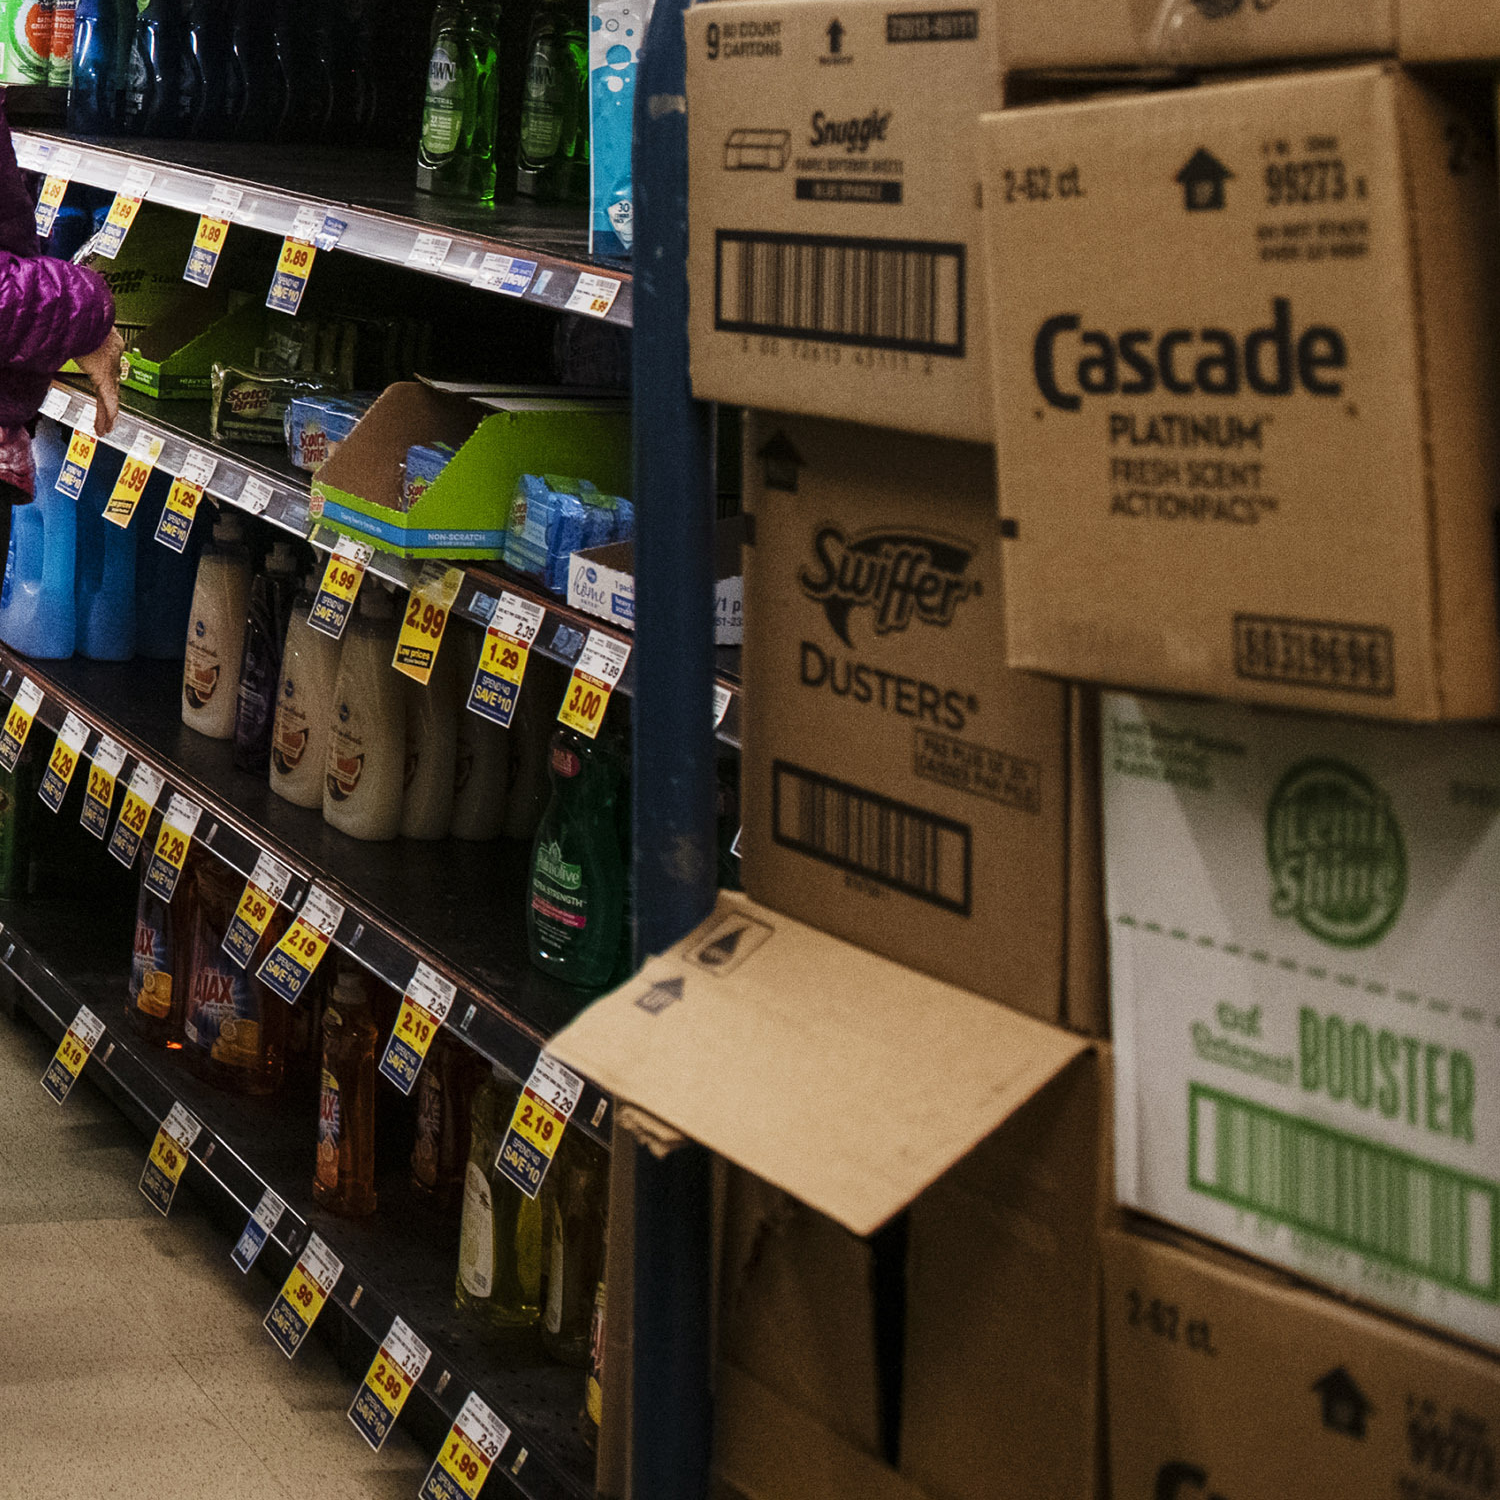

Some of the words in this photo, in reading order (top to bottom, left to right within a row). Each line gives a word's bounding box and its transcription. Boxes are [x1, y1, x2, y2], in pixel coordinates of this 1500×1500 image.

[706, 23, 720, 58] 9
[810, 109, 891, 151] Snuggle
[616, 203, 631, 213] 30
[200, 223, 221, 244] 3.89
[282, 247, 309, 268] 3.89
[505, 273, 531, 289] new
[1034, 297, 1347, 410] Cascade
[228, 387, 271, 403] Scotch
[232, 398, 269, 414] Brite
[299, 431, 327, 449] Scotch
[1109, 413, 1262, 450] PLATINUM
[71, 439, 91, 455] 4.99
[302, 447, 326, 464] Brite
[120, 461, 149, 493] 2.99
[1109, 459, 1179, 490] FRESH
[1184, 459, 1263, 493] SCENT
[171, 487, 197, 509] 1.29
[160, 520, 178, 538] SAVE
[427, 532, 487, 542] NON-SCRATCH
[328, 568, 356, 590] 4.99
[573, 565, 608, 606] home
[799, 518, 978, 638] Swiffer
[313, 603, 333, 620] SAVE
[332, 611, 344, 626] $10
[406, 597, 446, 639] 2.99
[514, 622, 536, 641] 2.39
[409, 649, 431, 661] prices
[490, 642, 520, 671] 1.29
[481, 675, 500, 691] SPEND
[601, 661, 620, 679] 3.89
[800, 640, 972, 730] DUSTERS
[474, 684, 496, 707] SAVE
[496, 696, 512, 713] $10
[568, 685, 602, 722] 3.00
[7, 710, 29, 740] 4.99
[53, 748, 74, 782] 2.29
[90, 770, 112, 804] 2.29
[121, 798, 147, 832] 2.29
[158, 831, 185, 866] 2.29
[149, 868, 166, 885] SAVE
[266, 881, 283, 900] 3.99
[242, 894, 267, 922] 2.99
[228, 928, 244, 949] SAVE
[286, 929, 318, 959] 2.19
[275, 953, 293, 971] SPEND
[265, 959, 289, 983] SAVE
[286, 974, 301, 993] $10
[427, 996, 447, 1019] 2.29
[401, 1010, 431, 1044] 2.19
[62, 1040, 83, 1066] 3.19
[385, 1048, 406, 1073] SAVE
[1298, 1002, 1478, 1147] BOOSTER
[551, 1089, 575, 1115] 2.29
[519, 1104, 555, 1142] 2.19
[156, 1141, 179, 1170] 1.99
[512, 1136, 532, 1157] SPEND
[502, 1145, 528, 1173] SAVE
[525, 1160, 541, 1185] $10
[316, 1268, 335, 1291] 1.19
[292, 1282, 314, 1308] .99
[270, 1309, 291, 1336] SAVE
[401, 1354, 422, 1379] 3.19
[373, 1363, 402, 1401] 2.99
[355, 1396, 376, 1426] SAVE
[372, 1416, 387, 1438] $10
[477, 1432, 500, 1458] 2.29
[447, 1442, 480, 1483] 1.99
